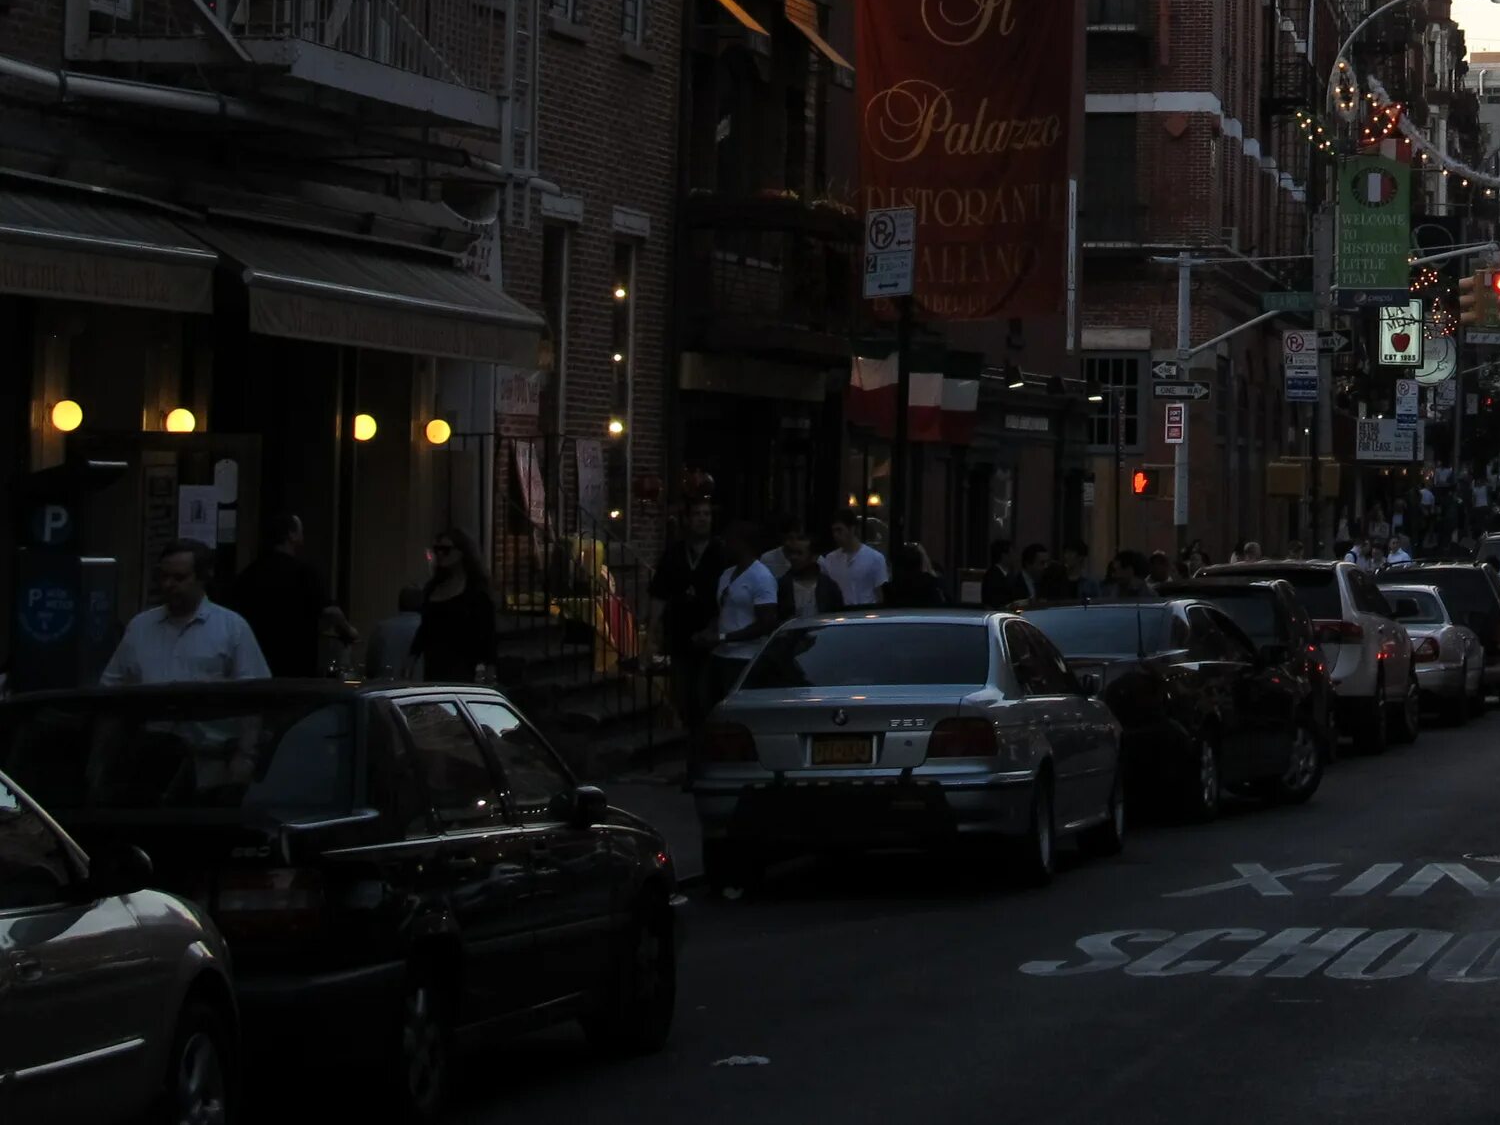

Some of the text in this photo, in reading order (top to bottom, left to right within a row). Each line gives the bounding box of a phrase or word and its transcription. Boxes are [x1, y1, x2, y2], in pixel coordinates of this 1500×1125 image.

[865, 79, 1063, 163] Palazzo
[1342, 213, 1406, 226] WELCOME
[1343, 228, 1358, 240] TO
[1342, 242, 1401, 255] HISTORIC
[1342, 258, 1387, 271] LITTLE
[1342, 273, 1378, 285] ITALY
[1384, 306, 1405, 319] LA
[1321, 337, 1342, 347] WAY
[1158, 365, 1173, 374] ONE
[1160, 387, 1203, 395] ONE WAY
[1372, 442, 1392, 452] LEASE
